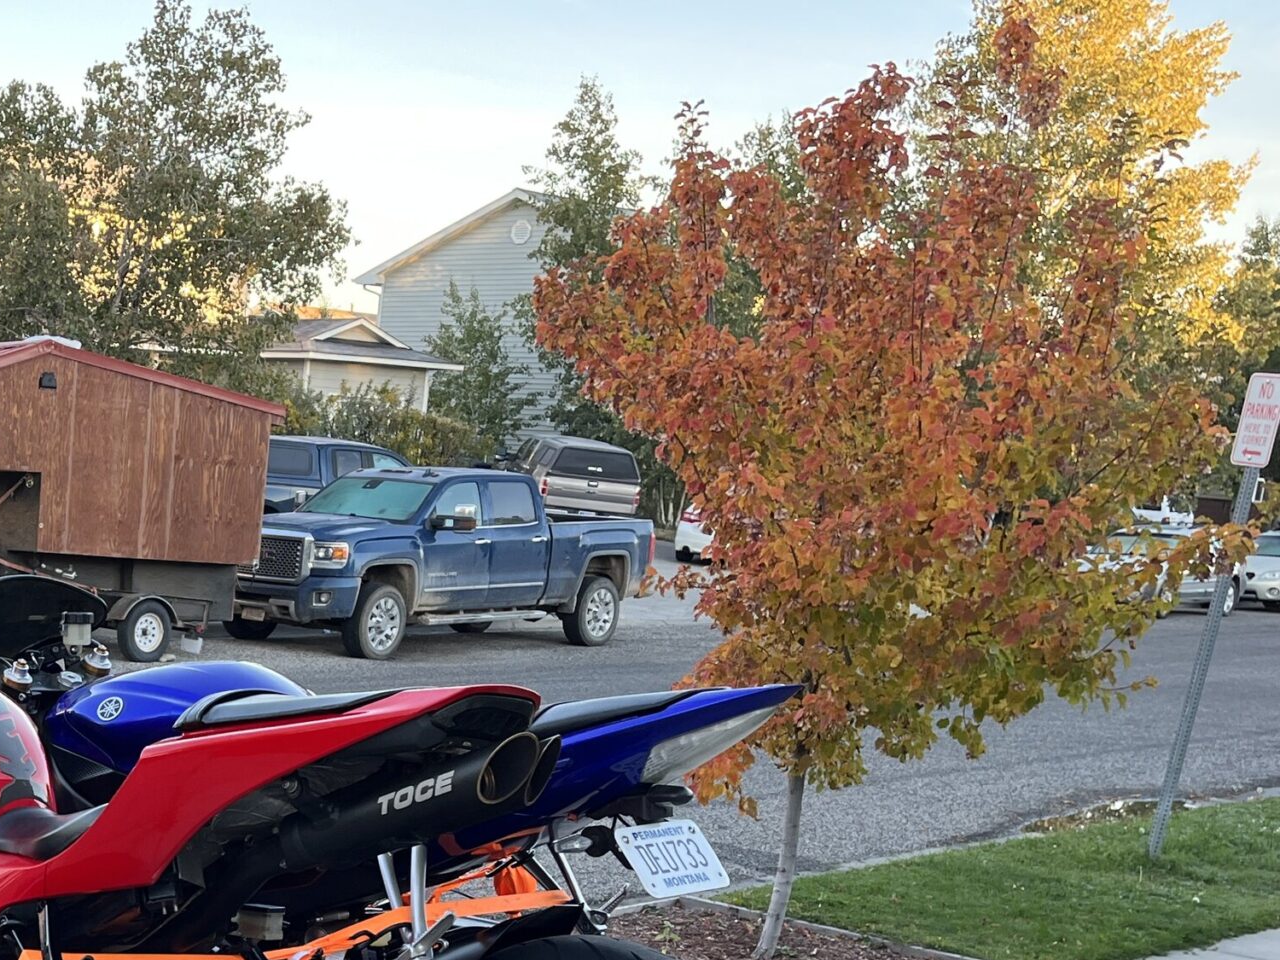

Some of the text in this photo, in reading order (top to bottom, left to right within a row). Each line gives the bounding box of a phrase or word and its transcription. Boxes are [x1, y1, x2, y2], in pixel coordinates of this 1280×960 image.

[1258, 383, 1274, 400] NO
[1244, 403, 1279, 420] PARKING
[377, 770, 455, 815] TOCE
[632, 826, 685, 841] PERMANENT
[634, 839, 708, 875] DEU733
[663, 872, 710, 888] MONTANA
